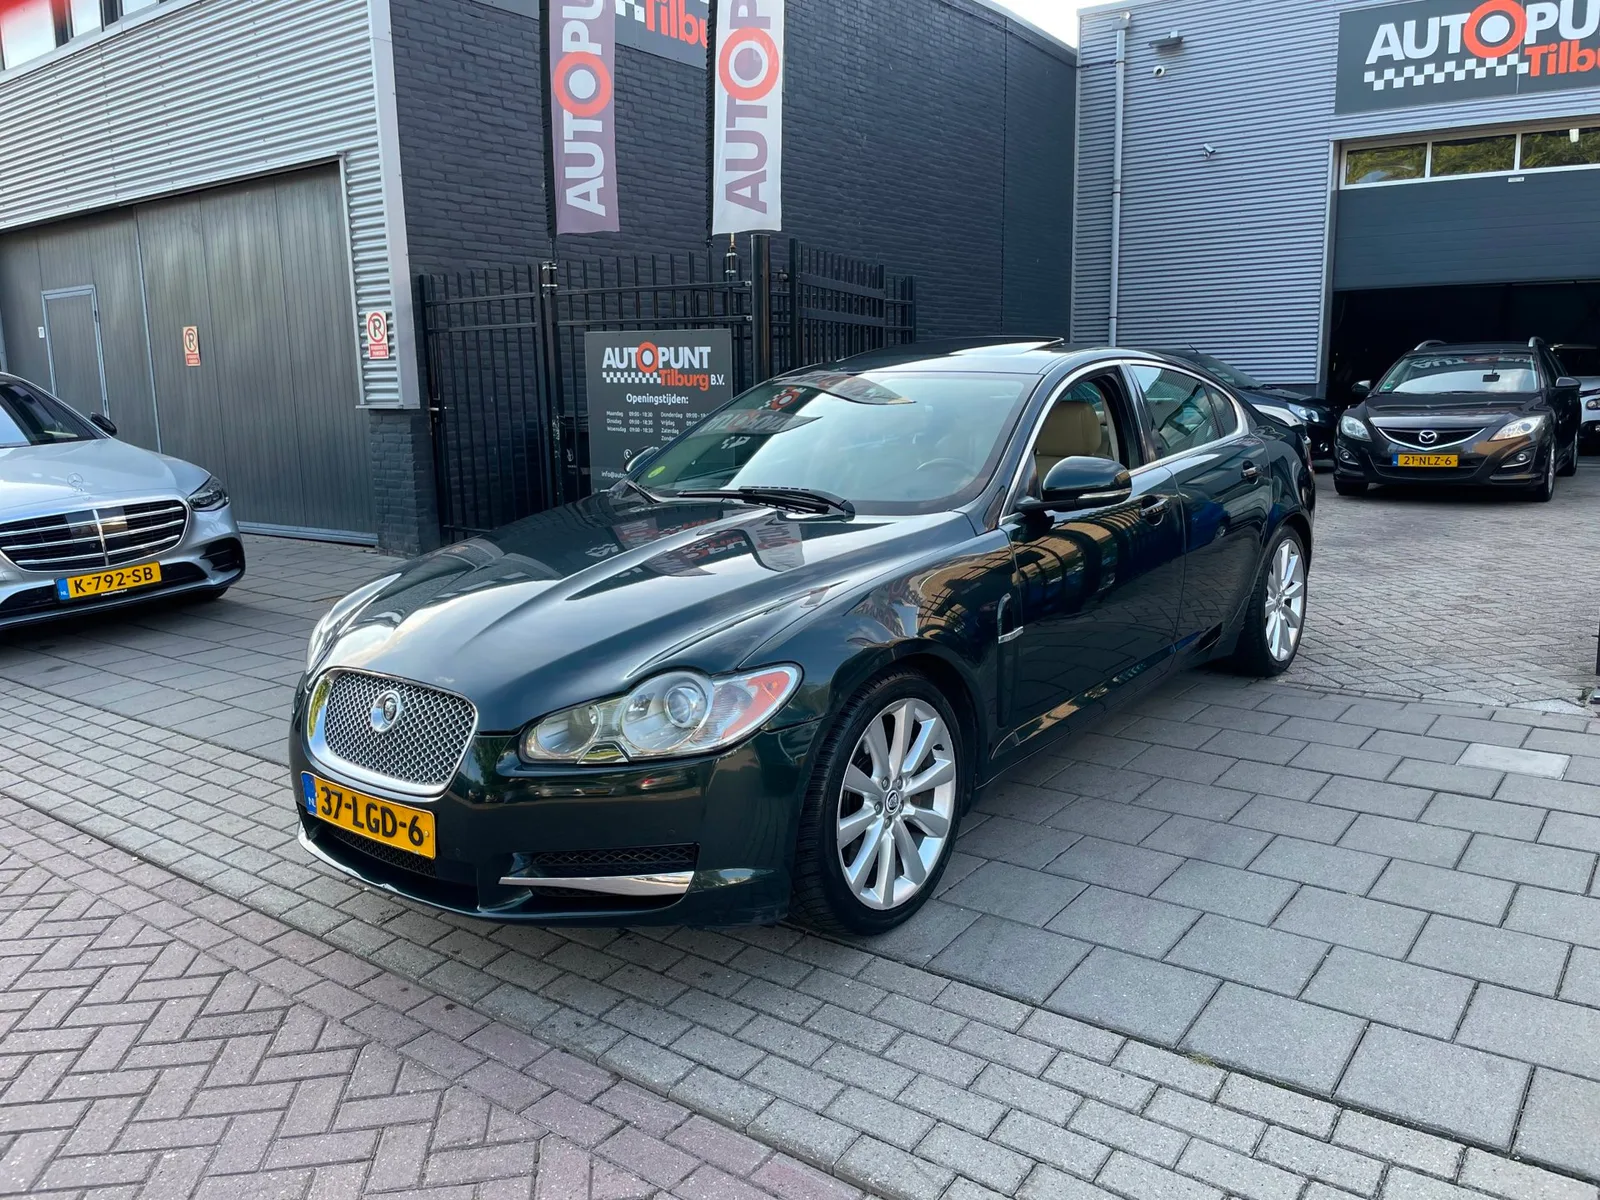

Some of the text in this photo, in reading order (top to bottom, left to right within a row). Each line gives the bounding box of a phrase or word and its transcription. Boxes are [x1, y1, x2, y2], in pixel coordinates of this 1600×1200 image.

[1524, 40, 1600, 77] Tilb
[602, 342, 711, 373] AUTOPUNT
[659, 369, 725, 391] Tilburg B.V.
[626, 393, 689, 405] Openingstijden:
[1403, 456, 1452, 466] 21-NLZ-6
[74, 566, 153, 594] K-792-SB
[308, 786, 424, 847] NL 37-LGD-6
